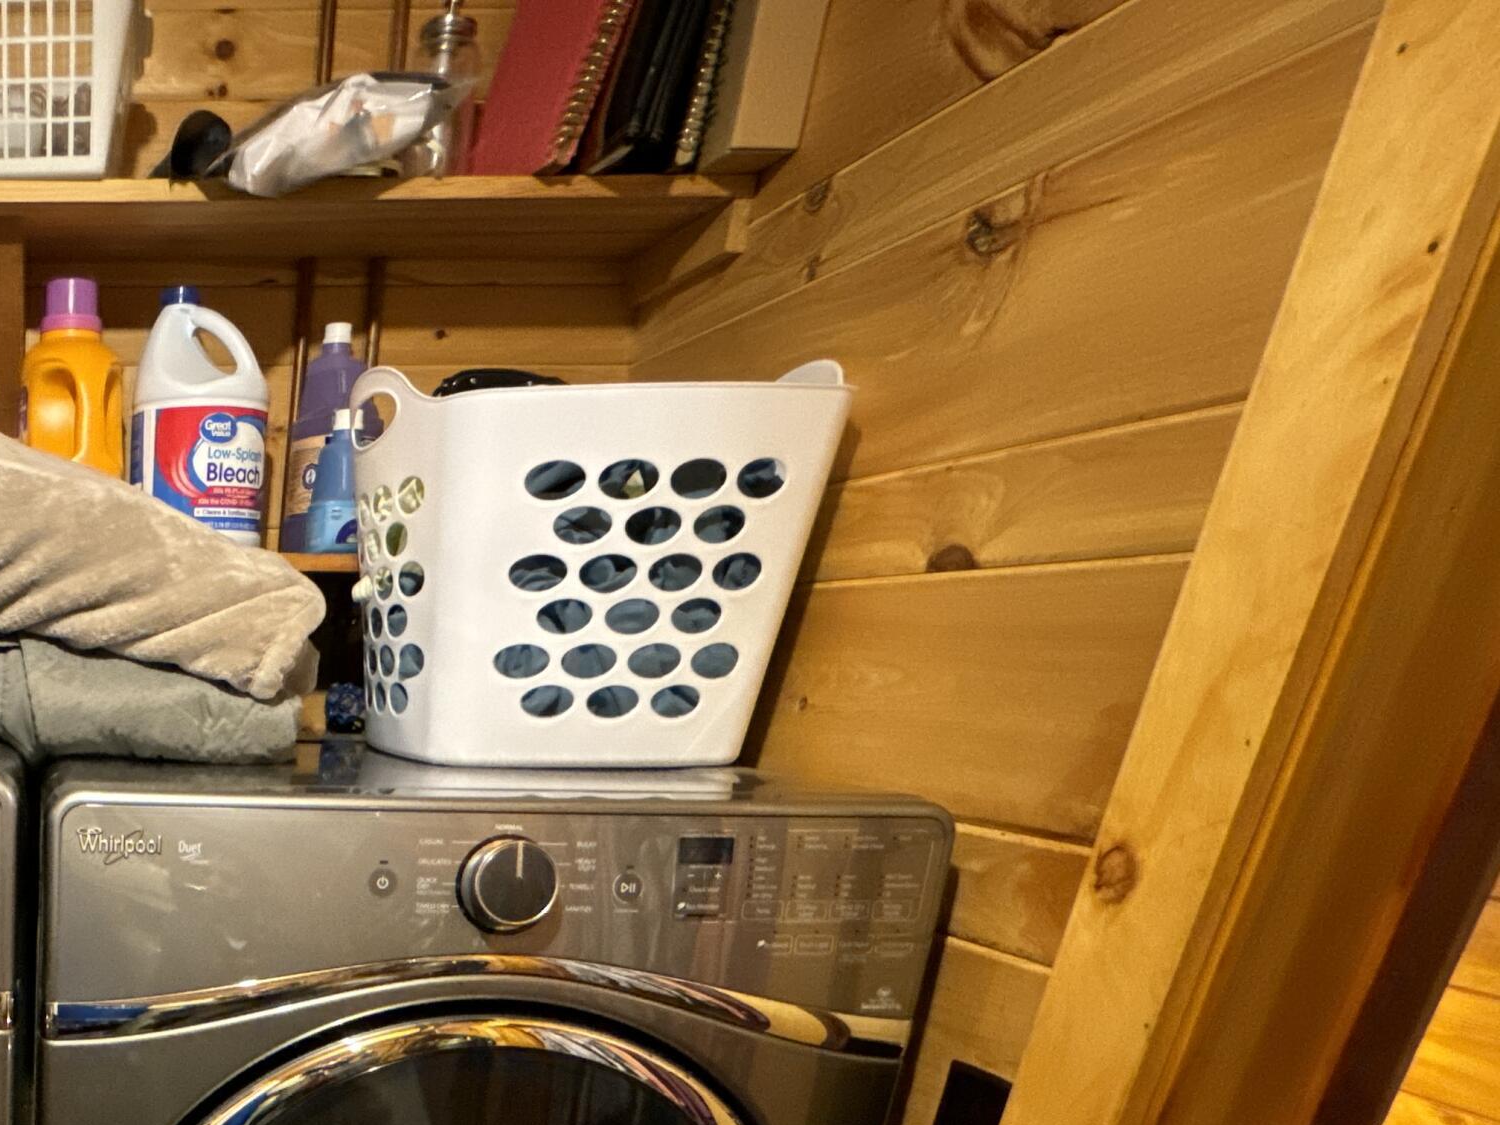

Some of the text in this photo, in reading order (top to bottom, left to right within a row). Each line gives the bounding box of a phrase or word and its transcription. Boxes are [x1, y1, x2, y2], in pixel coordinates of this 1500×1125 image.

[204, 418, 232, 432] Great
[207, 462, 260, 485] Bleach
[76, 827, 162, 859] Whirlpool
[177, 839, 202, 854] Duet
